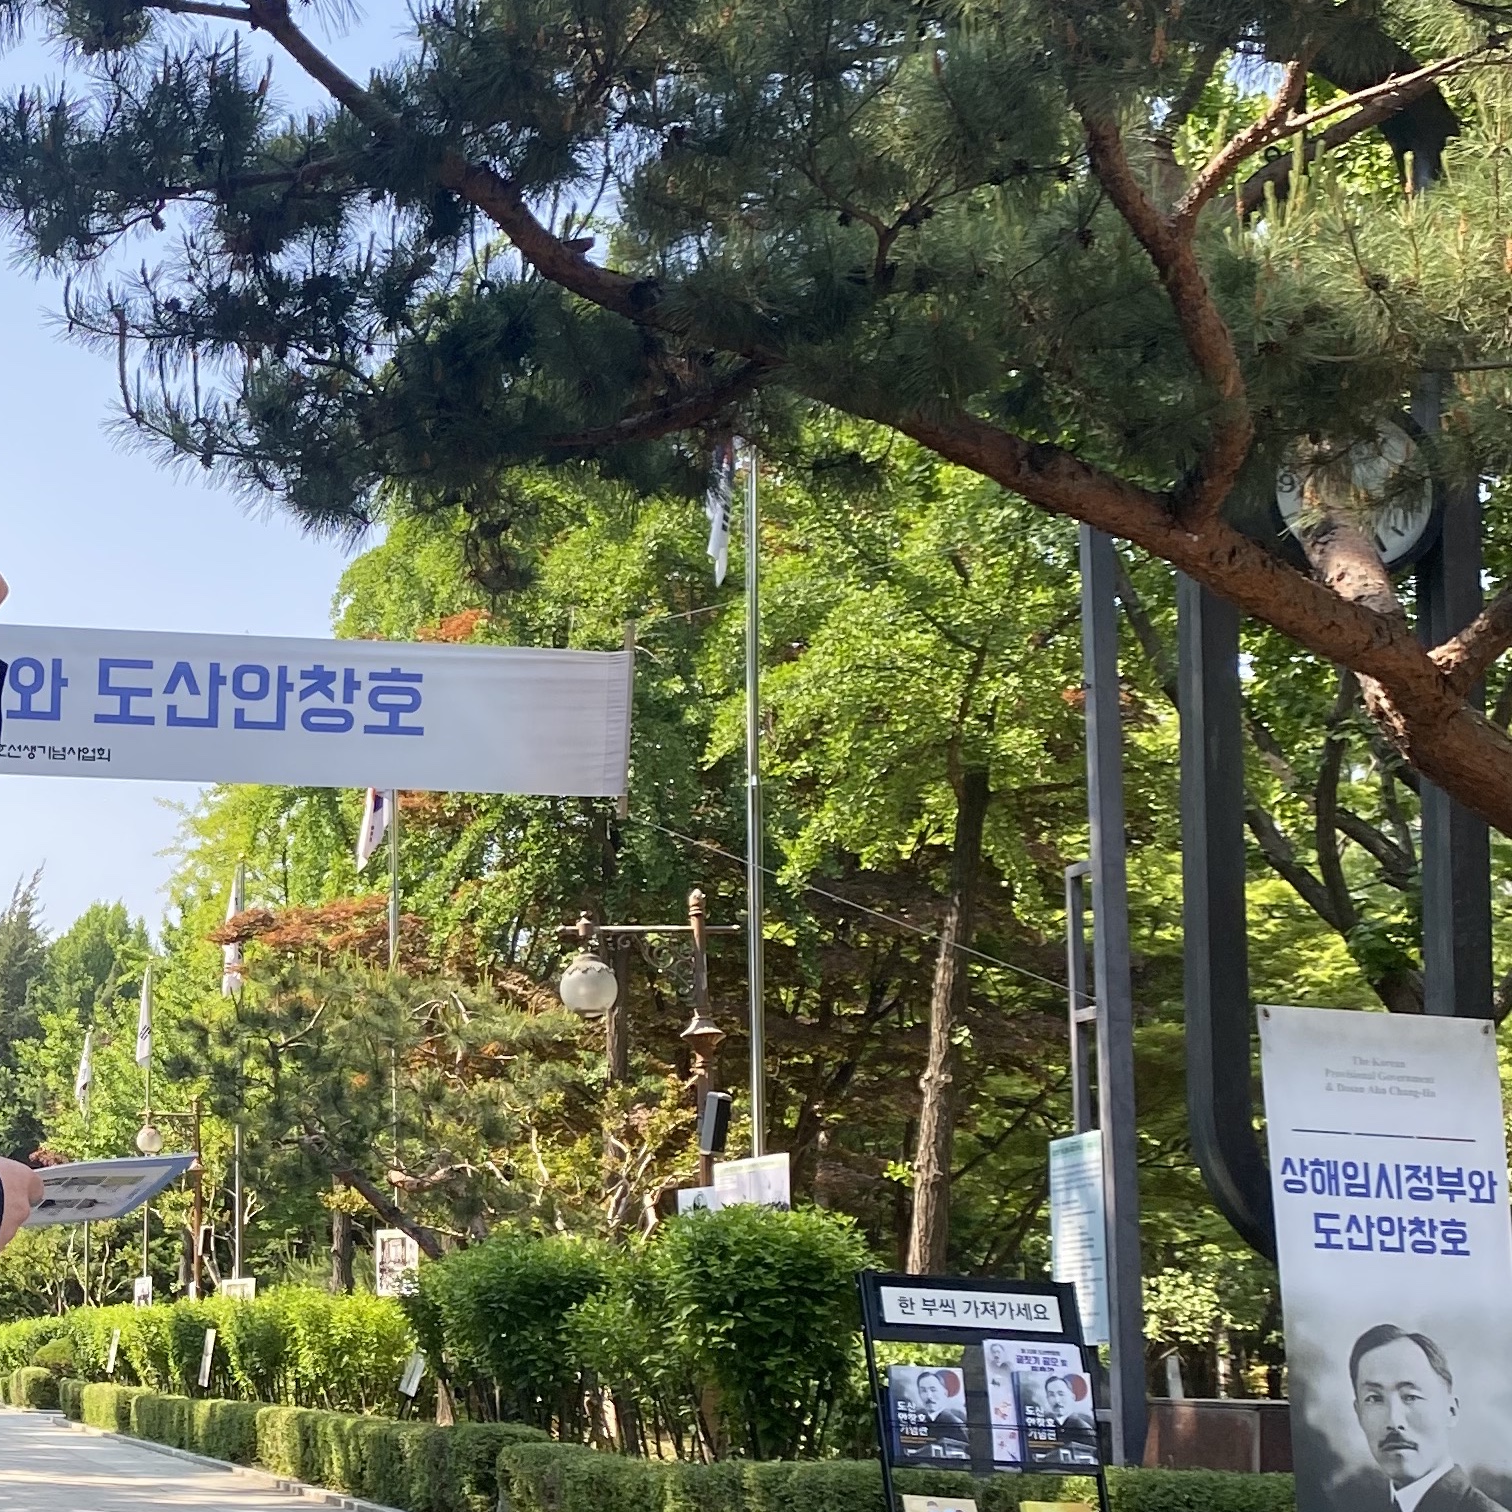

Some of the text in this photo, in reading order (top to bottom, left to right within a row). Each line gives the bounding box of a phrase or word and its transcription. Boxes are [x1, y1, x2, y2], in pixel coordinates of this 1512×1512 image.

[93, 657, 425, 737] 도산안창호
[1281, 1157, 1497, 1204] 상해임시정부와
[1313, 1212, 1471, 1256] 도산안창호
[898, 1296, 1050, 1322] 한 부씩 가져가세요
